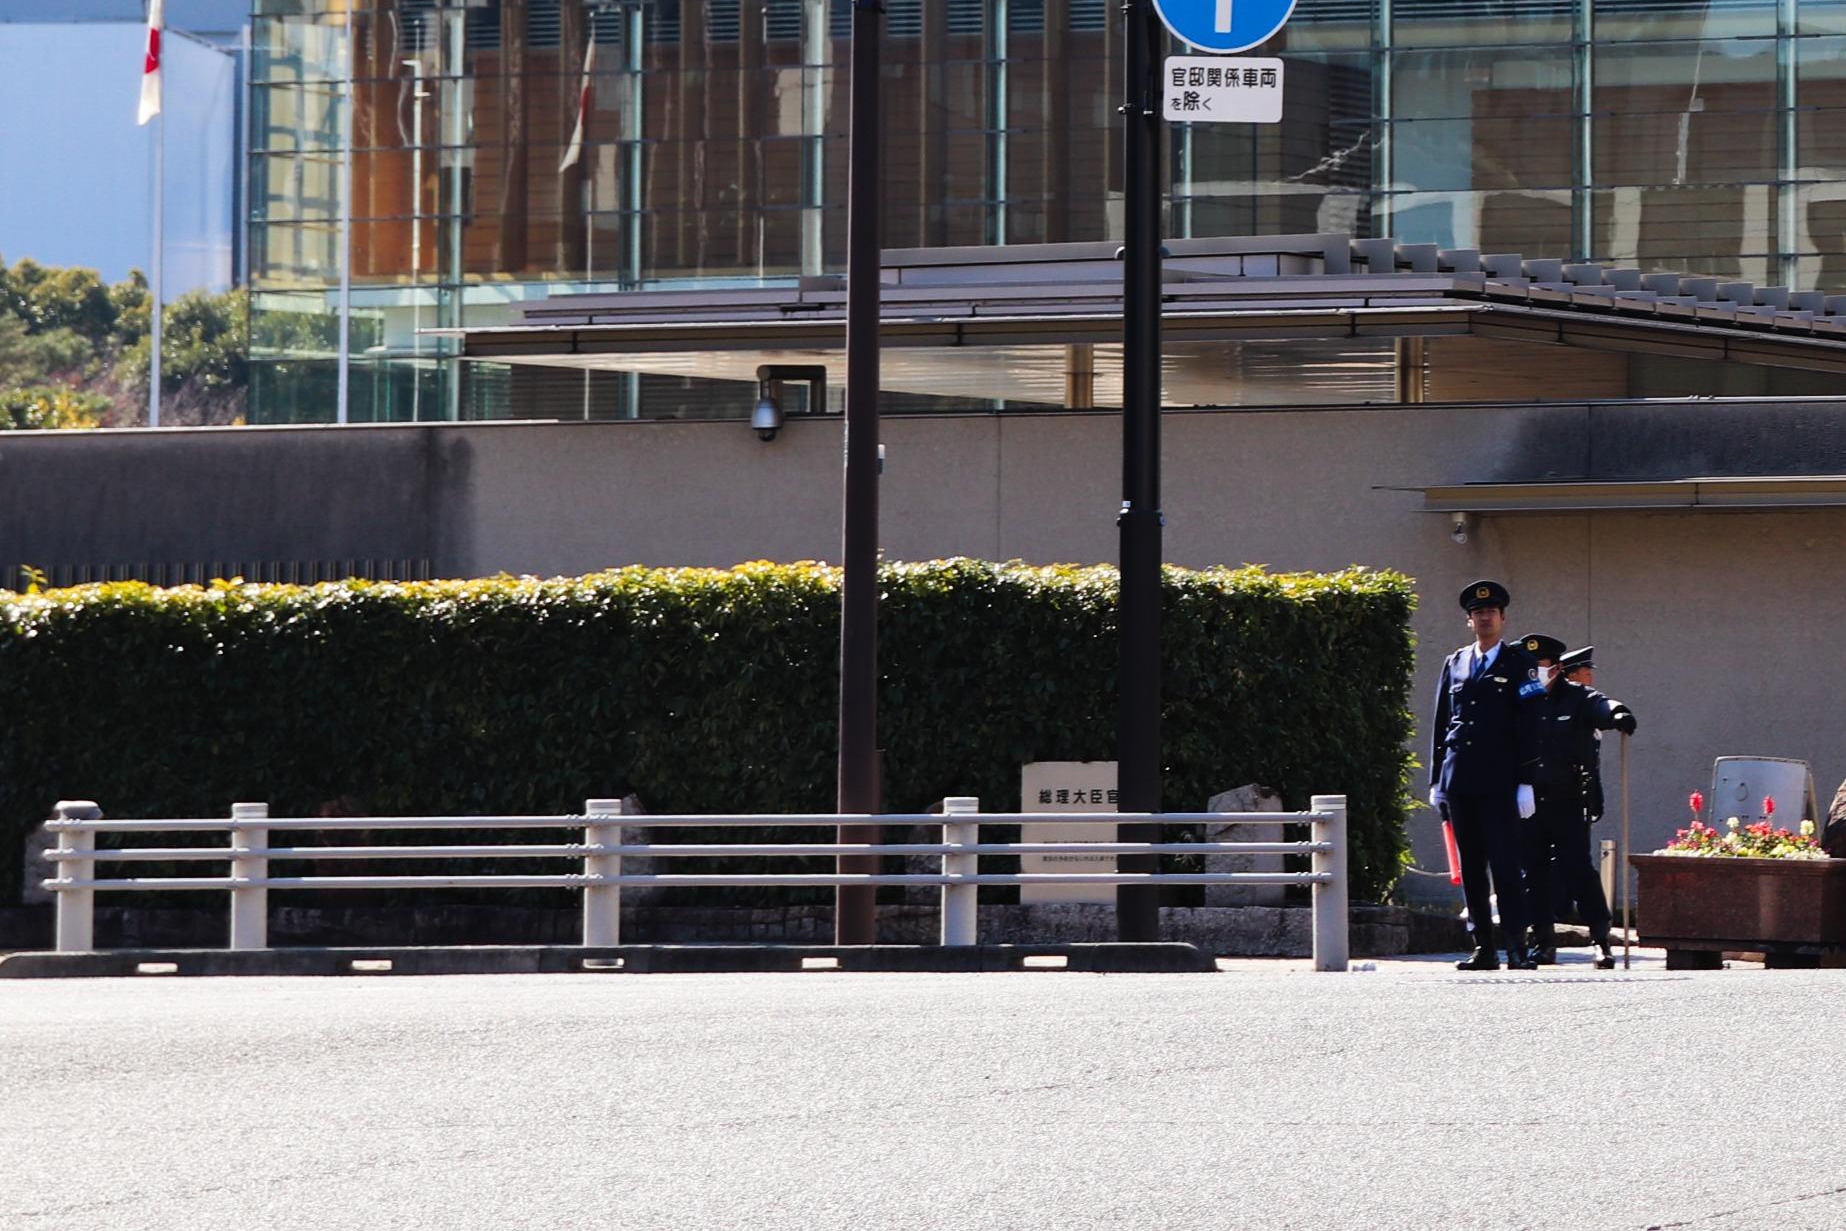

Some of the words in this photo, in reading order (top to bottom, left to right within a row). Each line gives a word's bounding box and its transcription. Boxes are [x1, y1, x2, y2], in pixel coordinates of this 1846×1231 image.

[1171, 67, 1277, 89] 官邸関係車両
[1171, 91, 1212, 111] を除く
